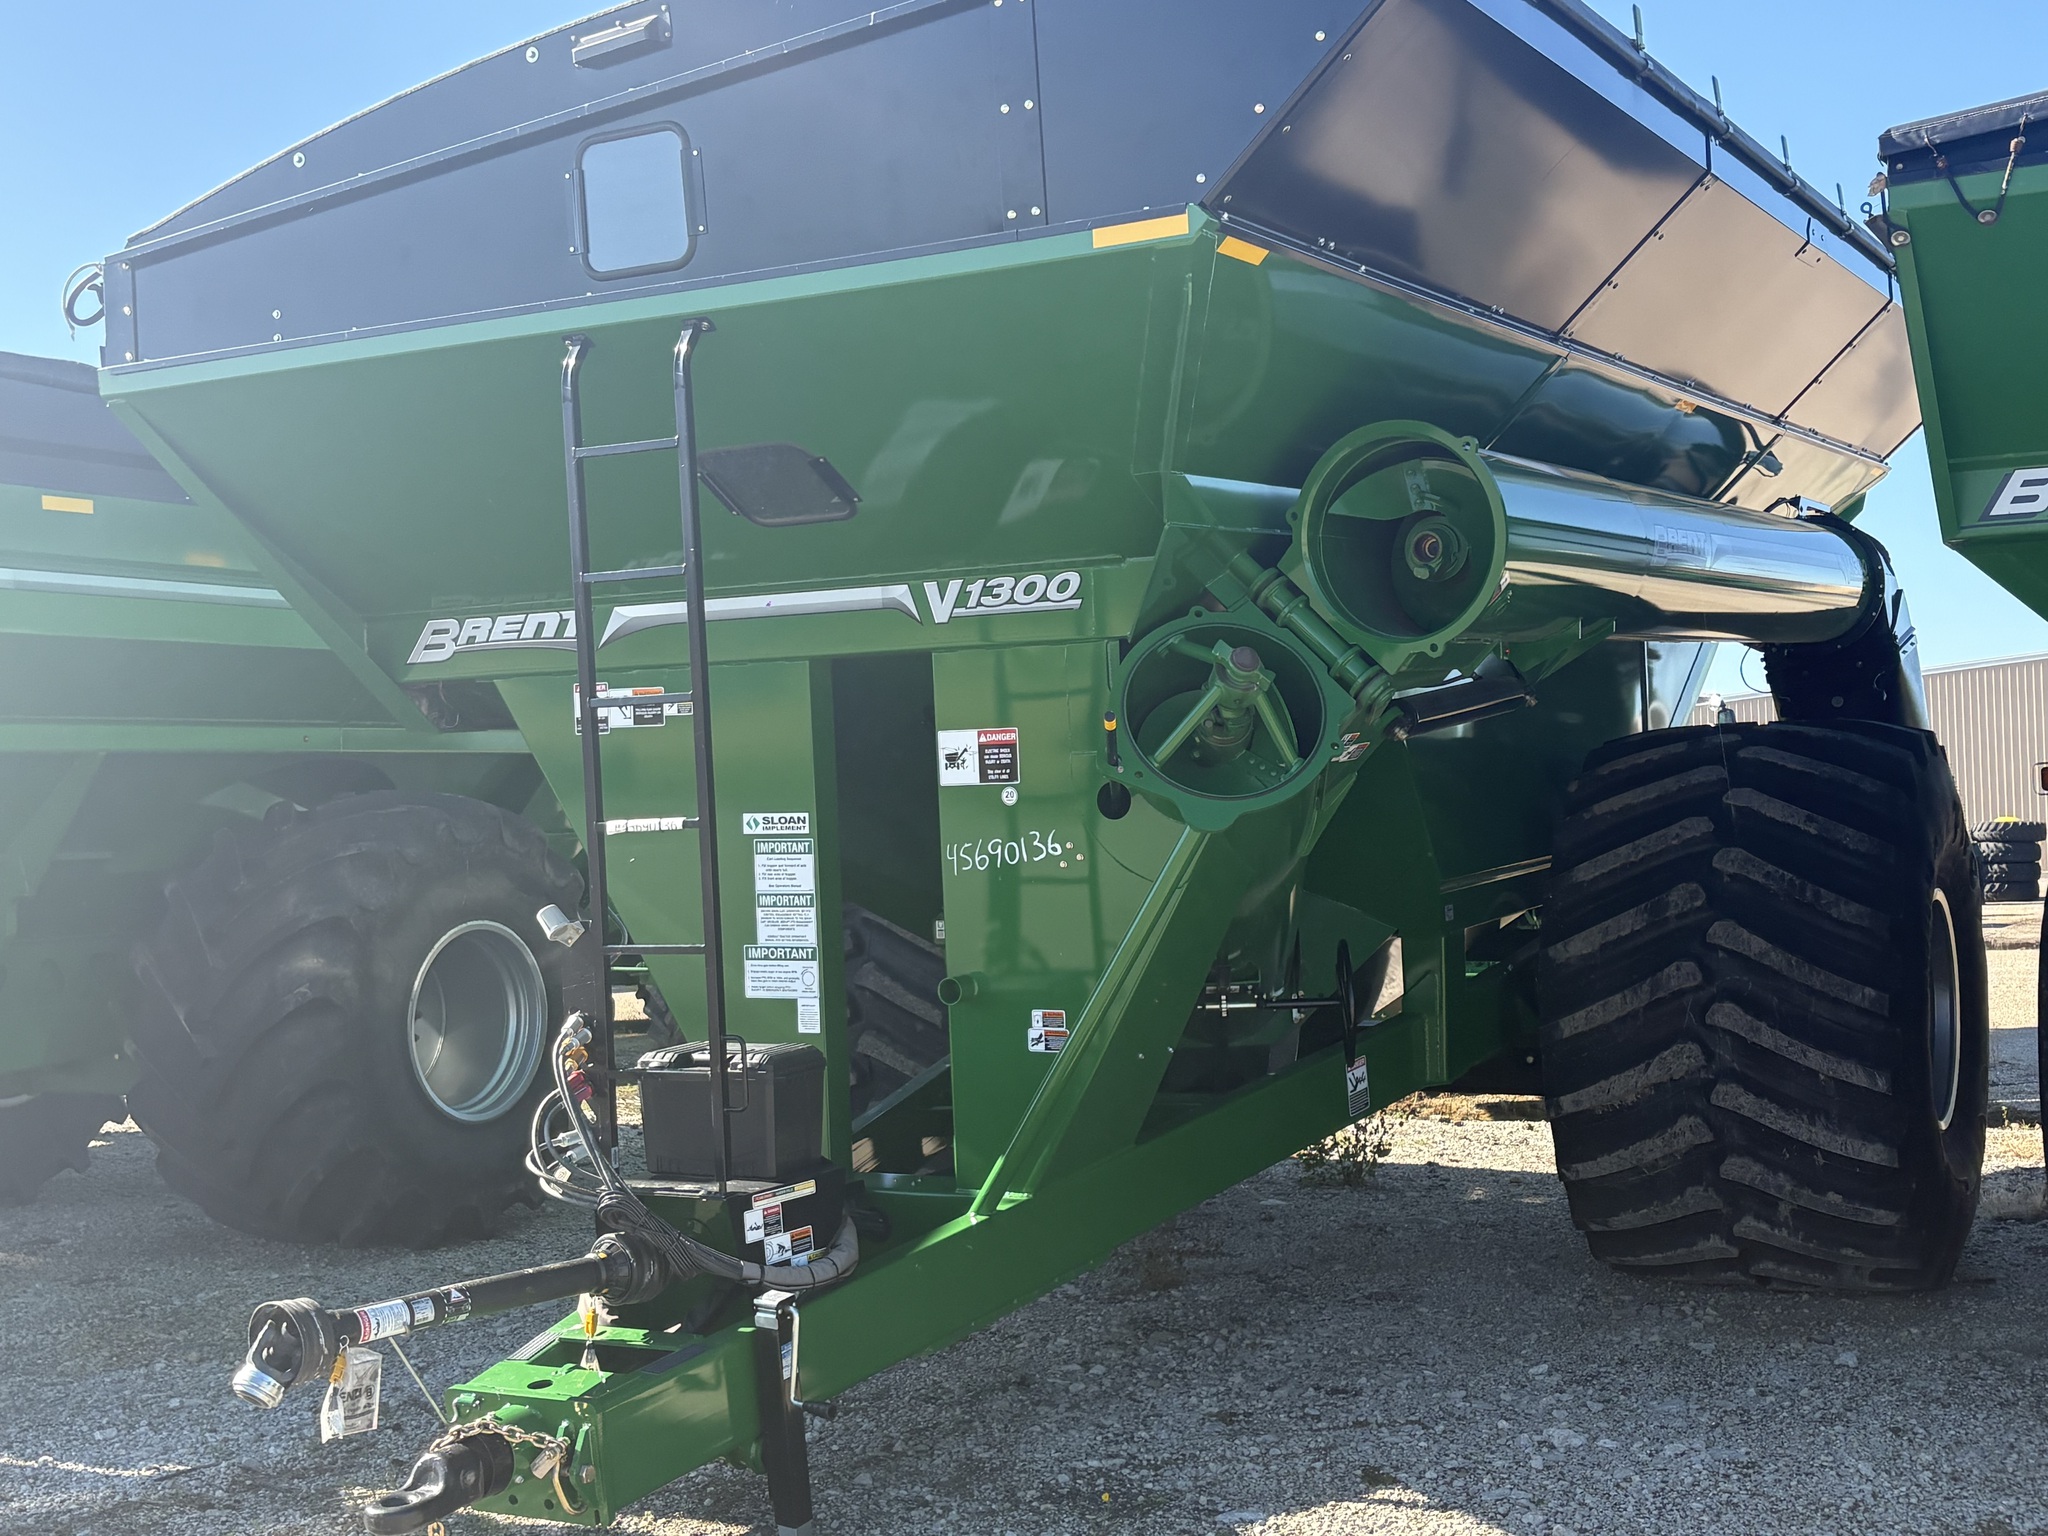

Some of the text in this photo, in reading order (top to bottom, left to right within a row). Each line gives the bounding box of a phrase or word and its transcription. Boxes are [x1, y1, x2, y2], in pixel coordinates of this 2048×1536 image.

[922, 571, 1082, 624] V1300
[406, 610, 578, 665] BRENT
[986, 732, 1016, 742] DANGER
[1005, 791, 1014, 799] 20
[762, 816, 806, 825] SLOAN
[757, 842, 810, 853] IMPORTANT
[946, 829, 1063, 876] 45690136
[759, 895, 812, 906] IMPORTANT
[748, 948, 814, 959] IMPORTANT
